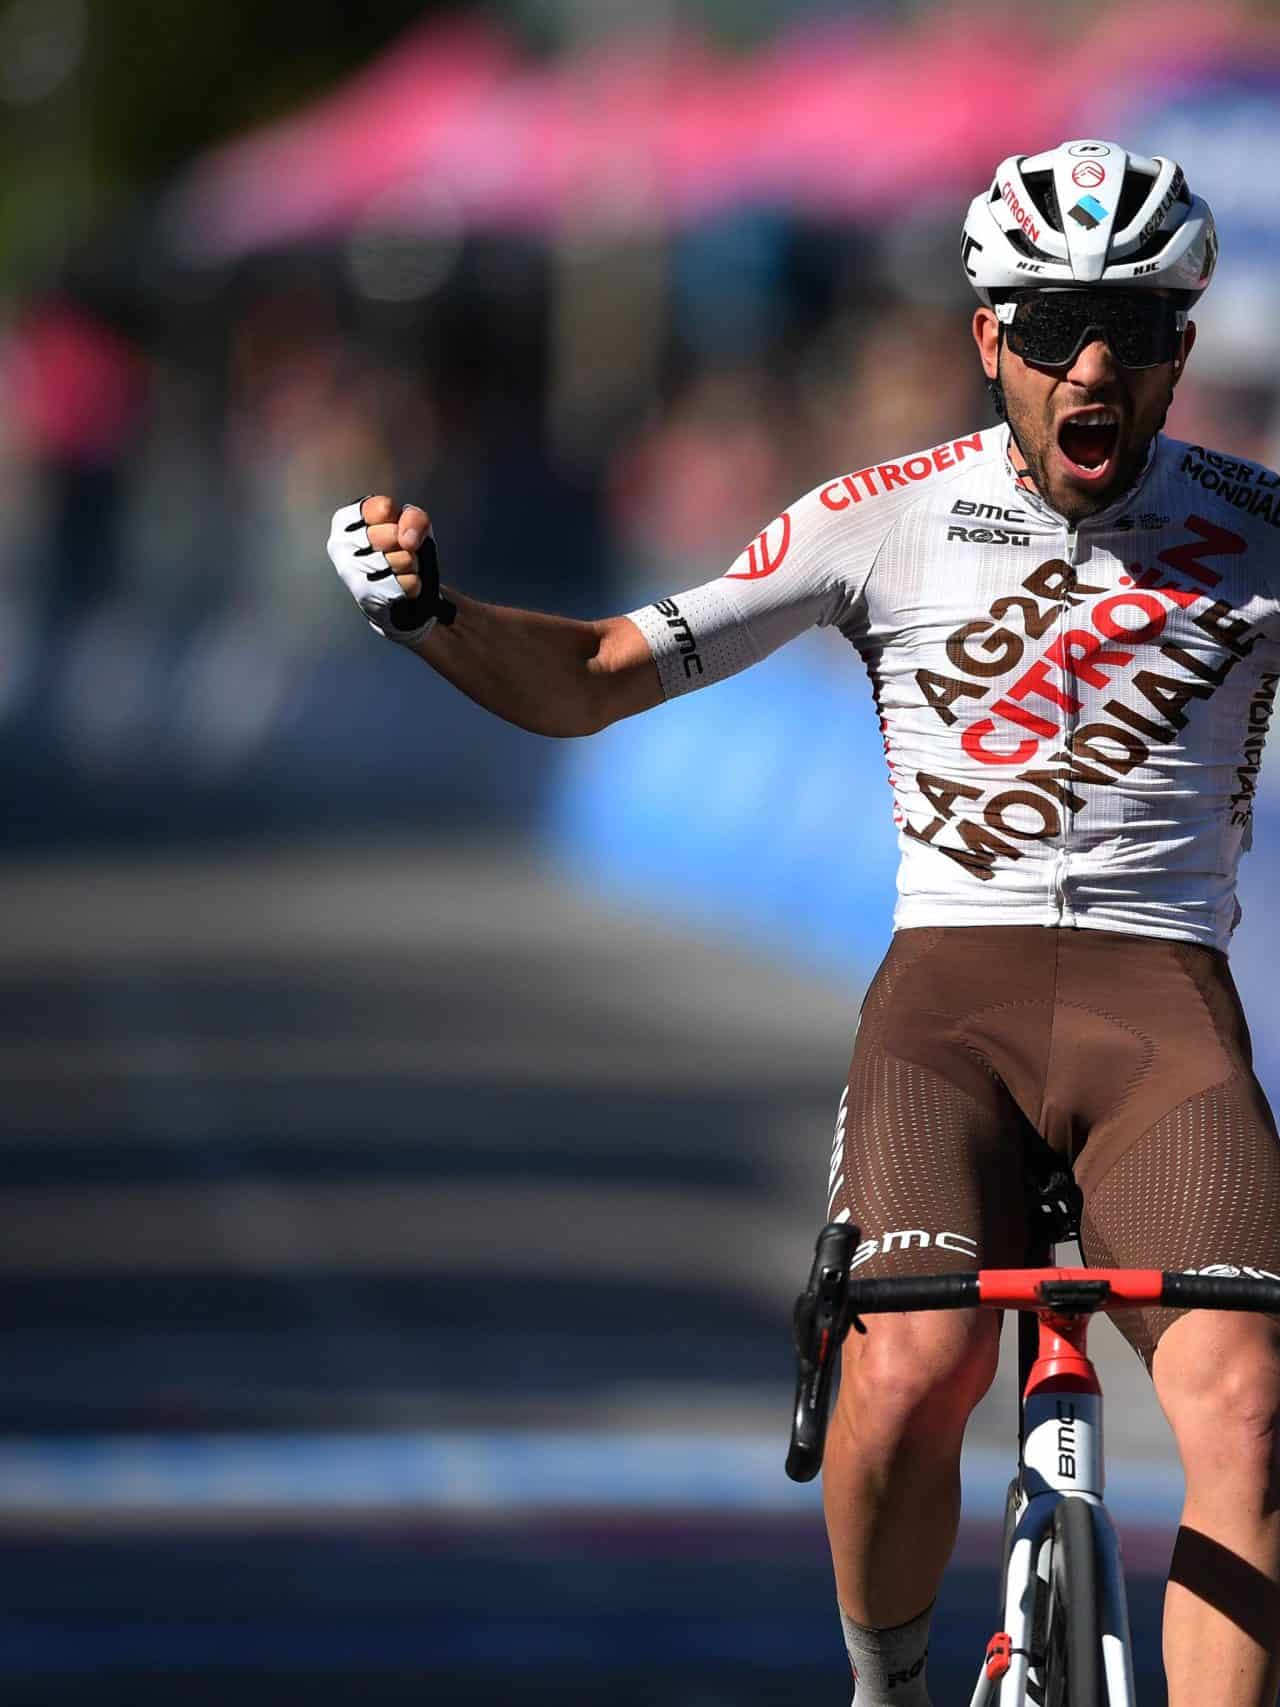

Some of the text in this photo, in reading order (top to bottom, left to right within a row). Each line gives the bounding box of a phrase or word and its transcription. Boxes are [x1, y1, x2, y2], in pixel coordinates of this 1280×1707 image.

[1002, 182, 1040, 242] CITROËN
[1016, 261, 1046, 274] HJC
[1133, 261, 1160, 275] HJC
[820, 433, 984, 512] CITROËN
[949, 498, 1027, 524] BMC
[653, 598, 704, 678] BMC
[915, 558, 1110, 725] AG2R
[961, 514, 1248, 765] CITROËN
[939, 598, 1266, 881] MONDIALE
[1056, 1399, 1076, 1479] BMC
